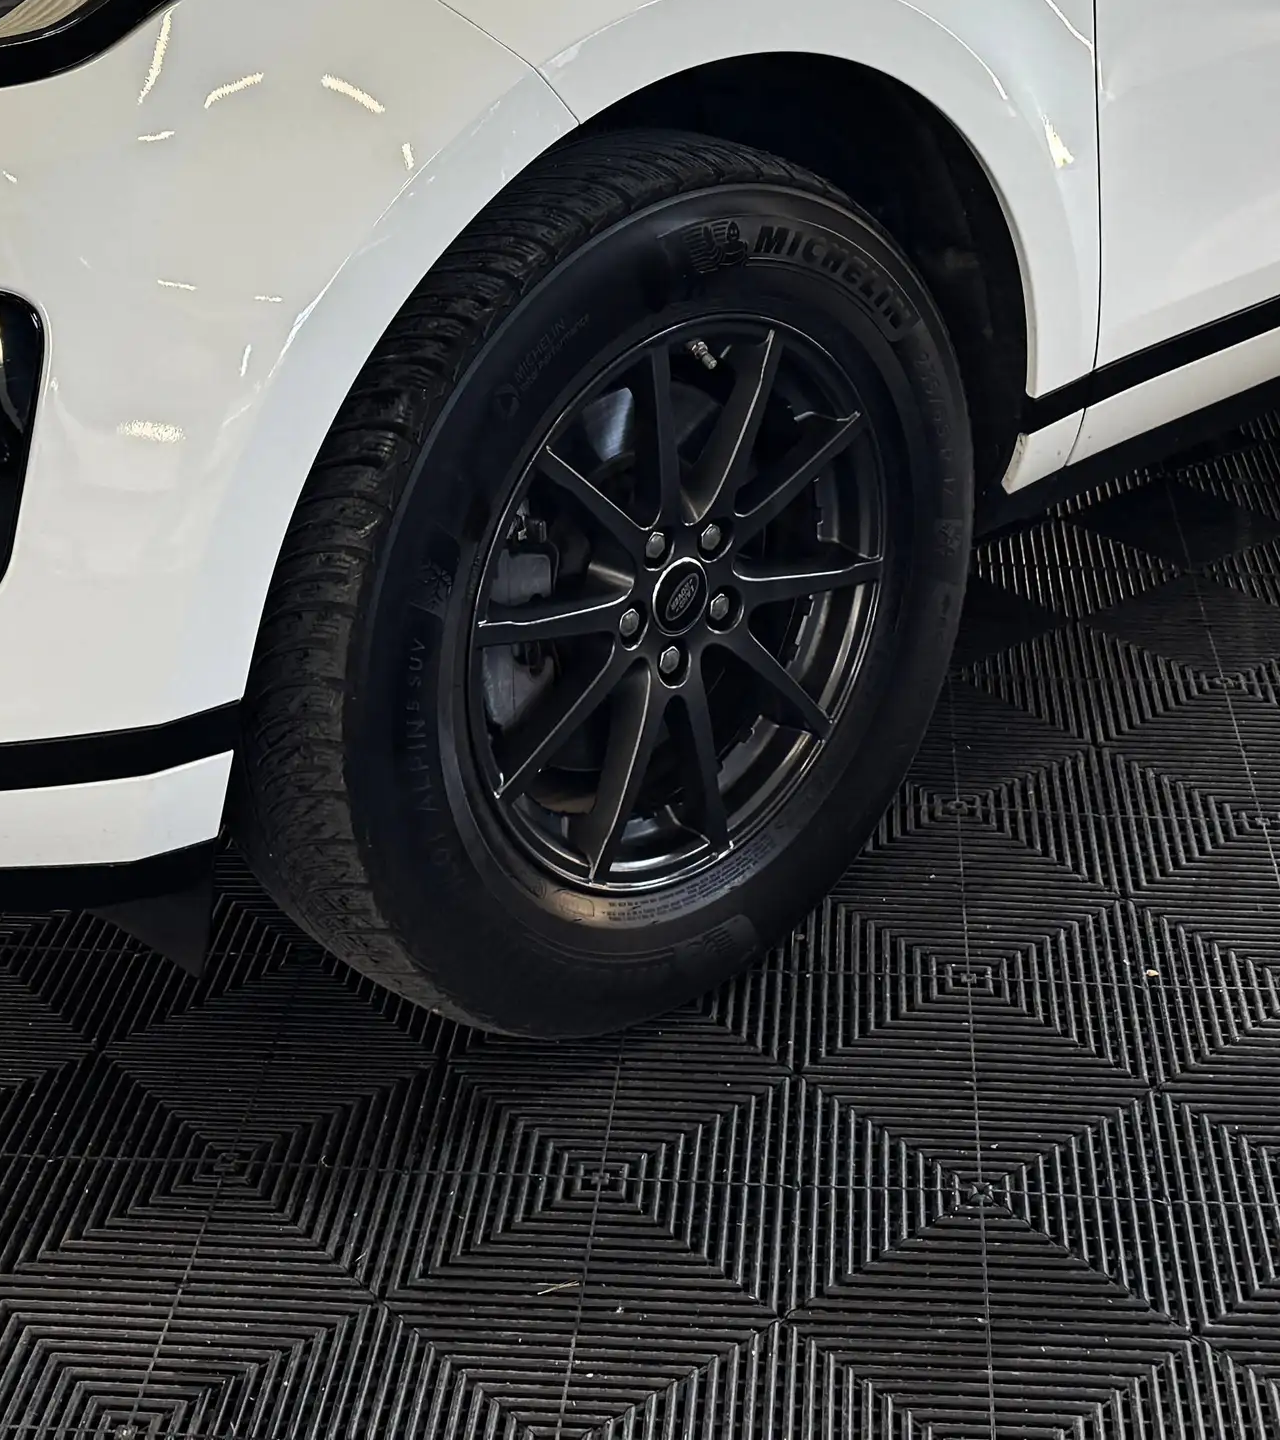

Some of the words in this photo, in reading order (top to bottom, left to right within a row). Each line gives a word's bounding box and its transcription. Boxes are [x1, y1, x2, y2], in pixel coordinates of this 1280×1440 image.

[753, 225, 913, 331] MICHELIN
[514, 317, 566, 383] MICHELIN
[408, 637, 426, 688] SUV
